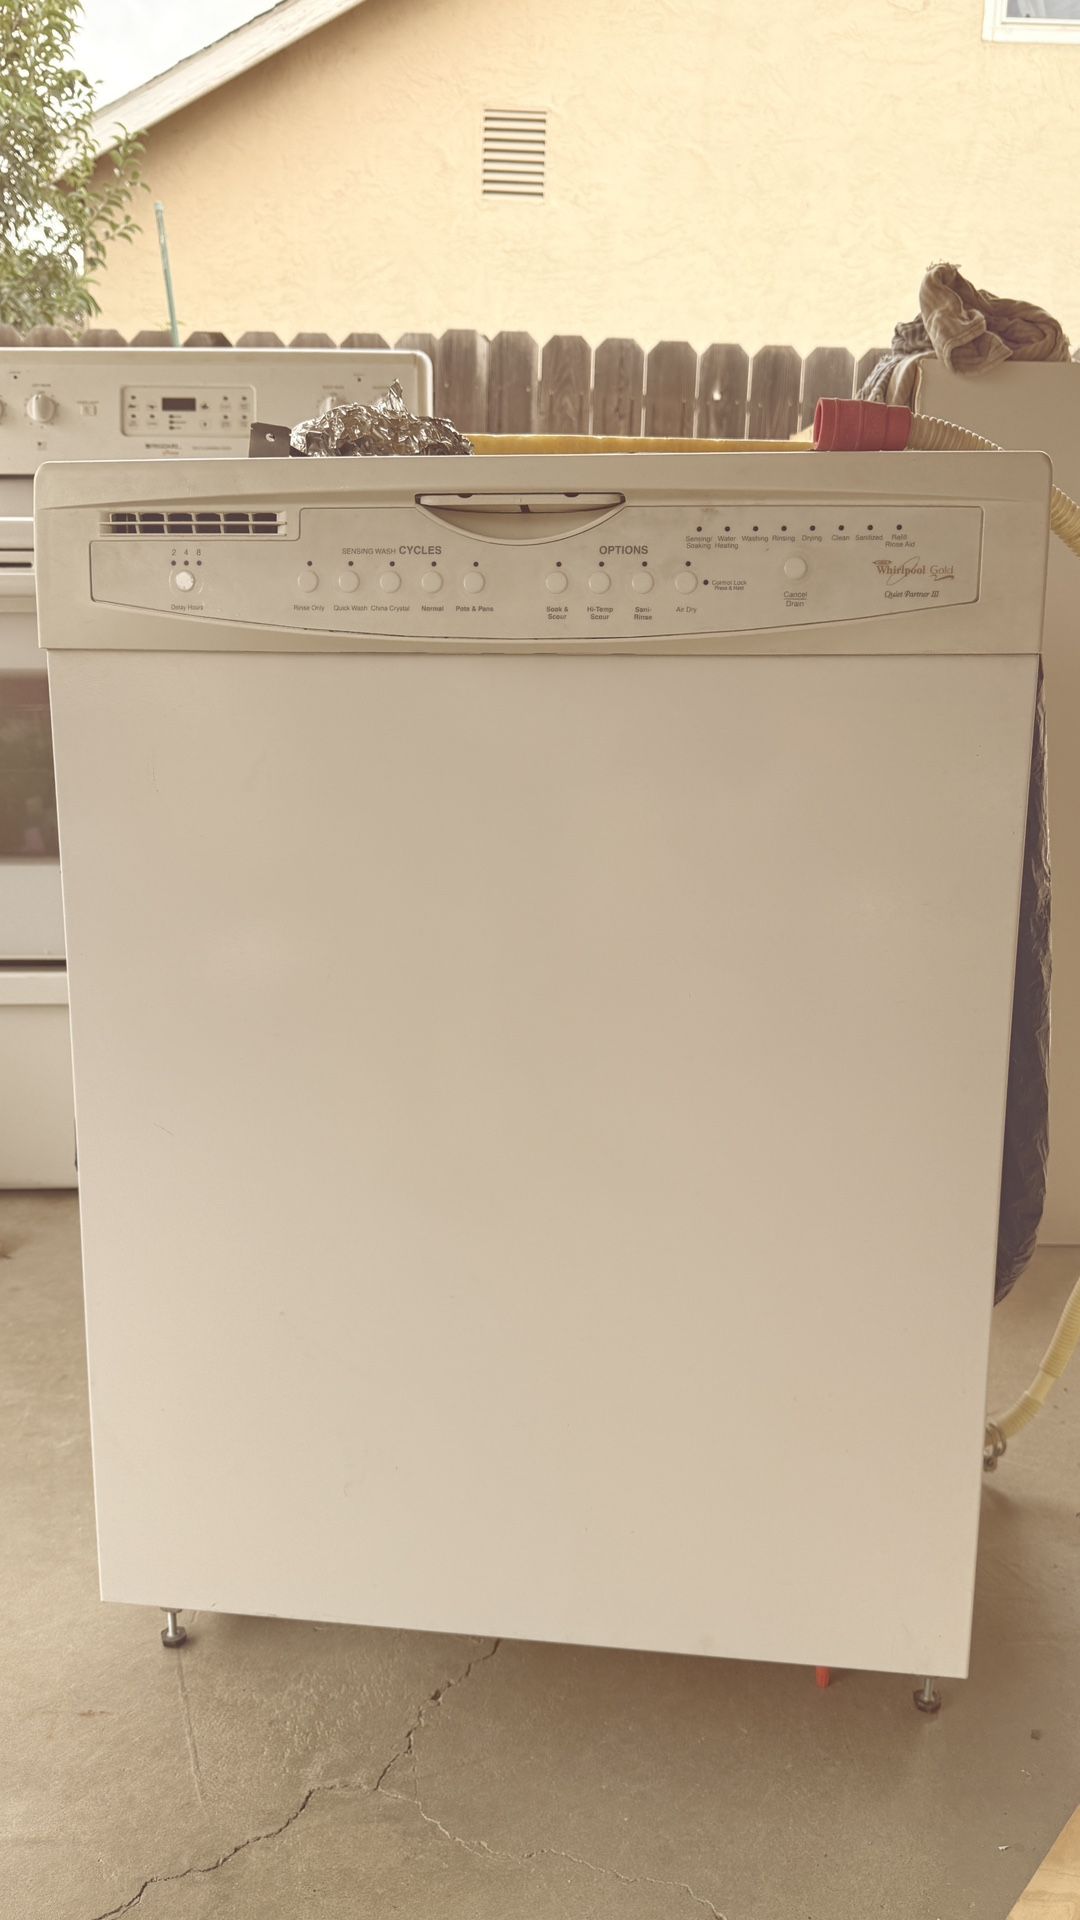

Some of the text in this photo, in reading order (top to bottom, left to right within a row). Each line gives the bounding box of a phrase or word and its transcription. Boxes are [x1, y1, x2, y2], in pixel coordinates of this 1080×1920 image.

[342, 545, 442, 555] SENSING WASH CYCLES
[599, 545, 648, 555] OPTIONS
[876, 564, 954, 577] Whirlpool Gold
[884, 591, 903, 599] Quiet
